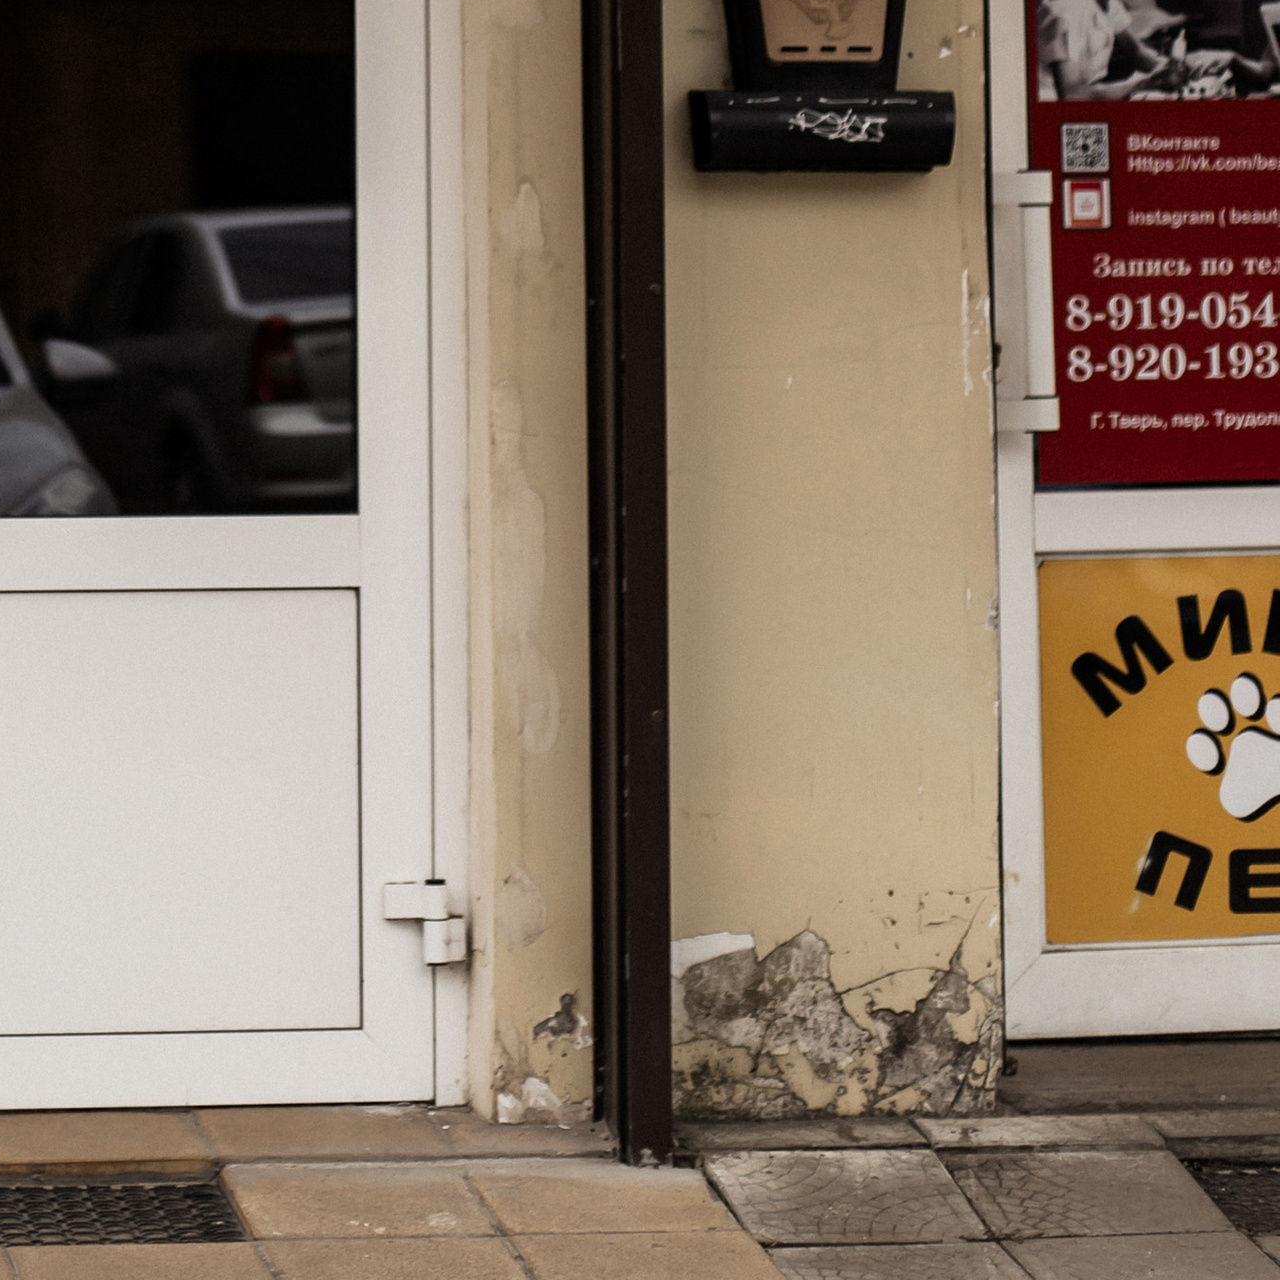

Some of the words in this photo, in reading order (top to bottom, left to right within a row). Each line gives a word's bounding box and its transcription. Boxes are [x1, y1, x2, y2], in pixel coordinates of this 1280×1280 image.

[1126, 133, 1221, 152] ВКонтакте
[1127, 152, 1280, 176] Https://vk.com/be
[1127, 207, 1216, 230] instagram
[1229, 206, 1280, 228] beaut
[1092, 251, 1193, 279] Запись
[1199, 255, 1235, 277] по
[1090, 410, 1106, 430] Г.
[1107, 410, 1169, 433] Тверь,
[1170, 411, 1211, 433] пер.
[1212, 408, 1280, 432] Трудол
